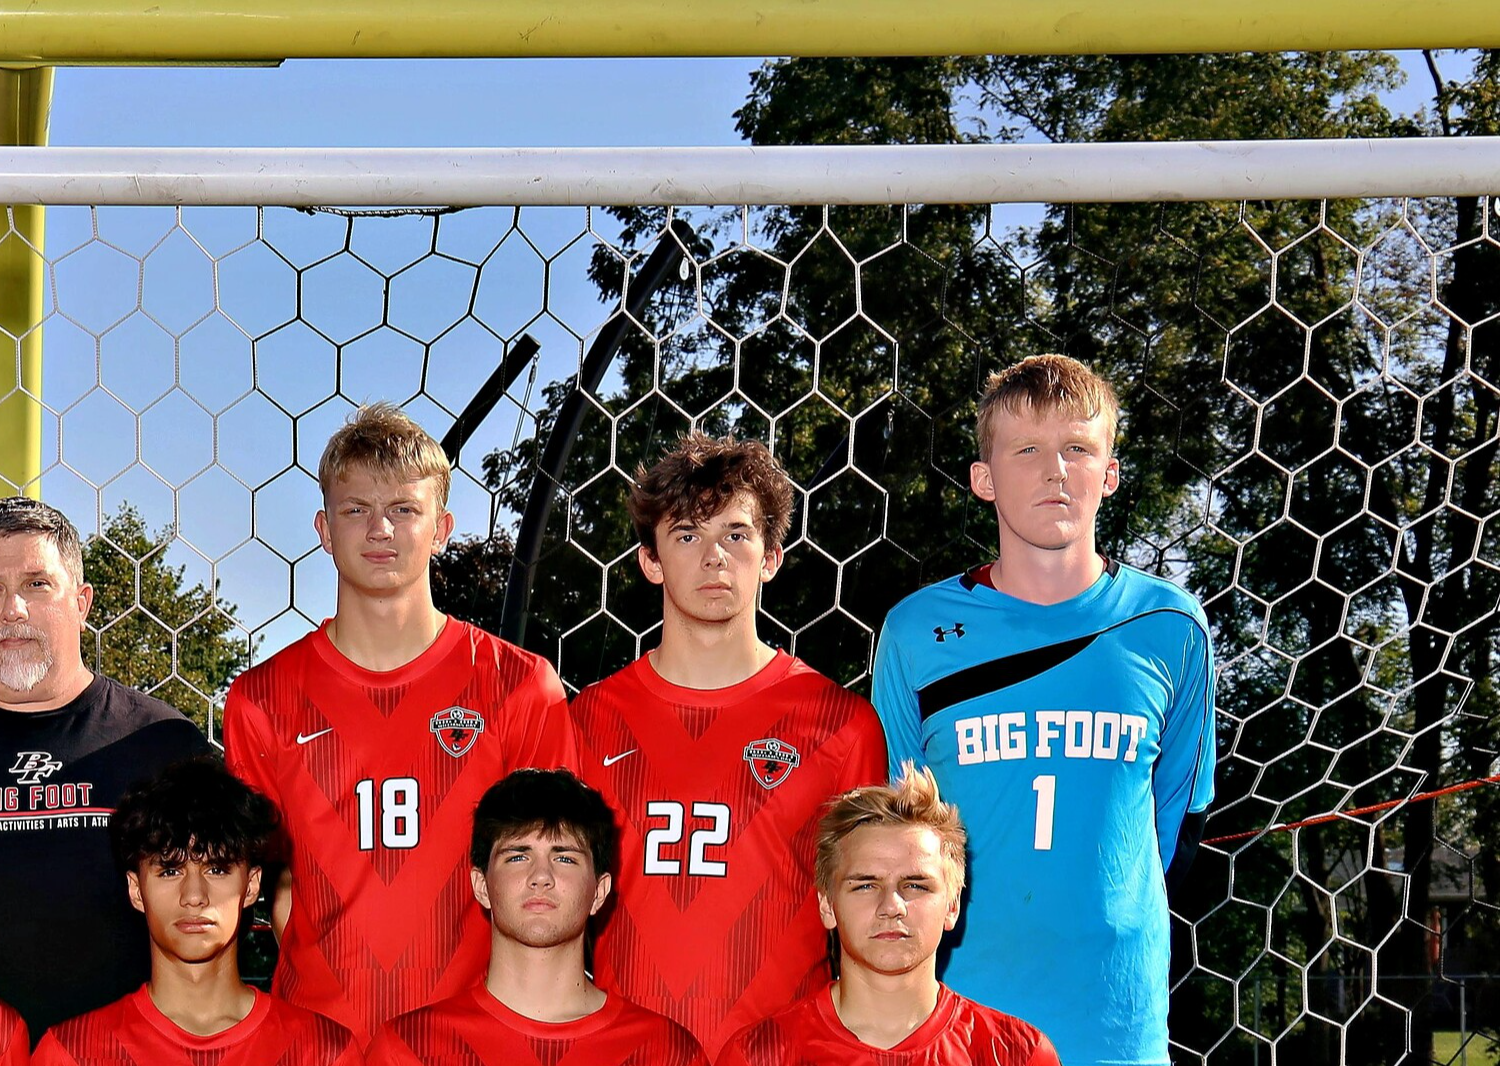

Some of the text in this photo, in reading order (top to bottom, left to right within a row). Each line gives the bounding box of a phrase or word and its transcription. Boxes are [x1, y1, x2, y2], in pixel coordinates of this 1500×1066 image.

[954, 710, 1149, 767] BIG FOOT
[29, 783, 93, 811] FOOT
[57, 817, 79, 829] ARTS
[354, 776, 421, 852] 18
[1031, 774, 1057, 851] 1
[643, 800, 732, 878] 22
